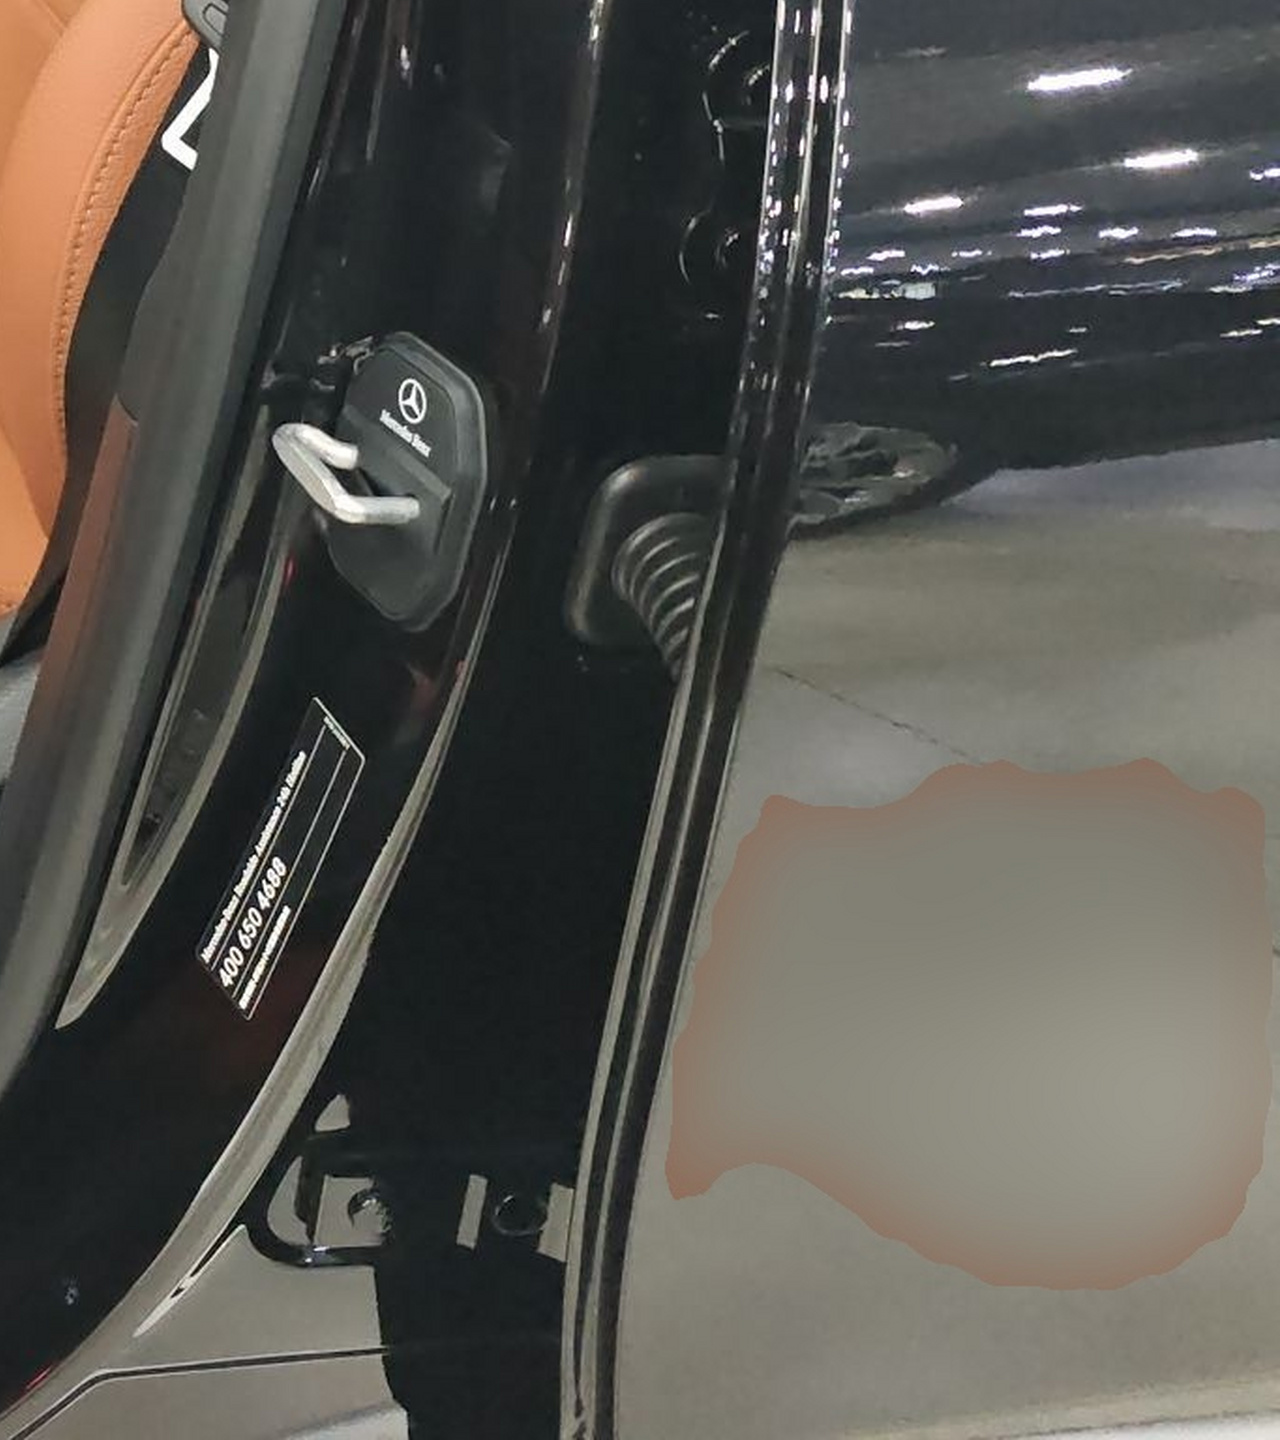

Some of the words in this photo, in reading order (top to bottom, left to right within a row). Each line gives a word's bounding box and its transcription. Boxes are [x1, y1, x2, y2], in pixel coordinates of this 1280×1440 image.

[219, 946, 244, 987] 400
[238, 906, 263, 950] 650
[256, 856, 287, 910] 4688
